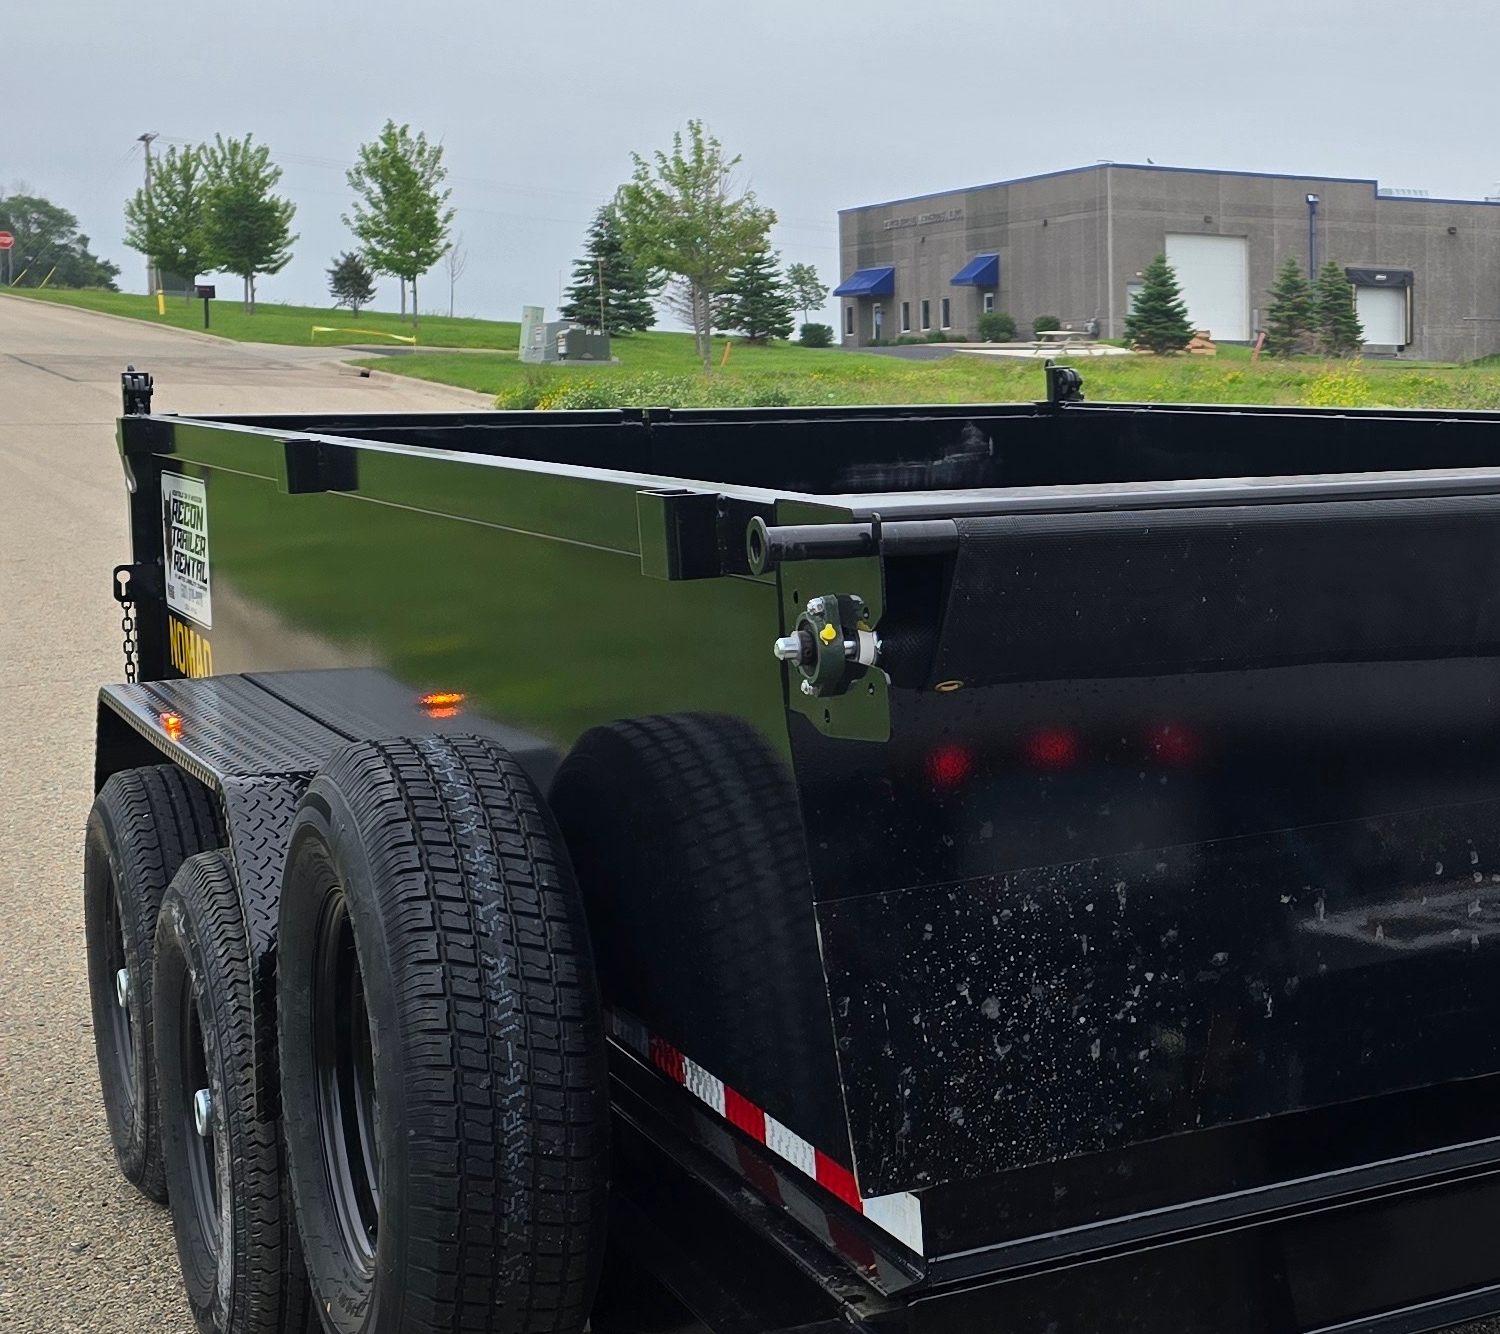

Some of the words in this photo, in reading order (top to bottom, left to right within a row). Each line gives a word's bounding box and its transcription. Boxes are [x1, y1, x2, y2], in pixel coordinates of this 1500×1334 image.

[172, 497, 204, 532] RECON
[171, 525, 206, 559] TRAILER
[174, 550, 208, 585] RENTAL
[168, 614, 213, 679] NOMAD
